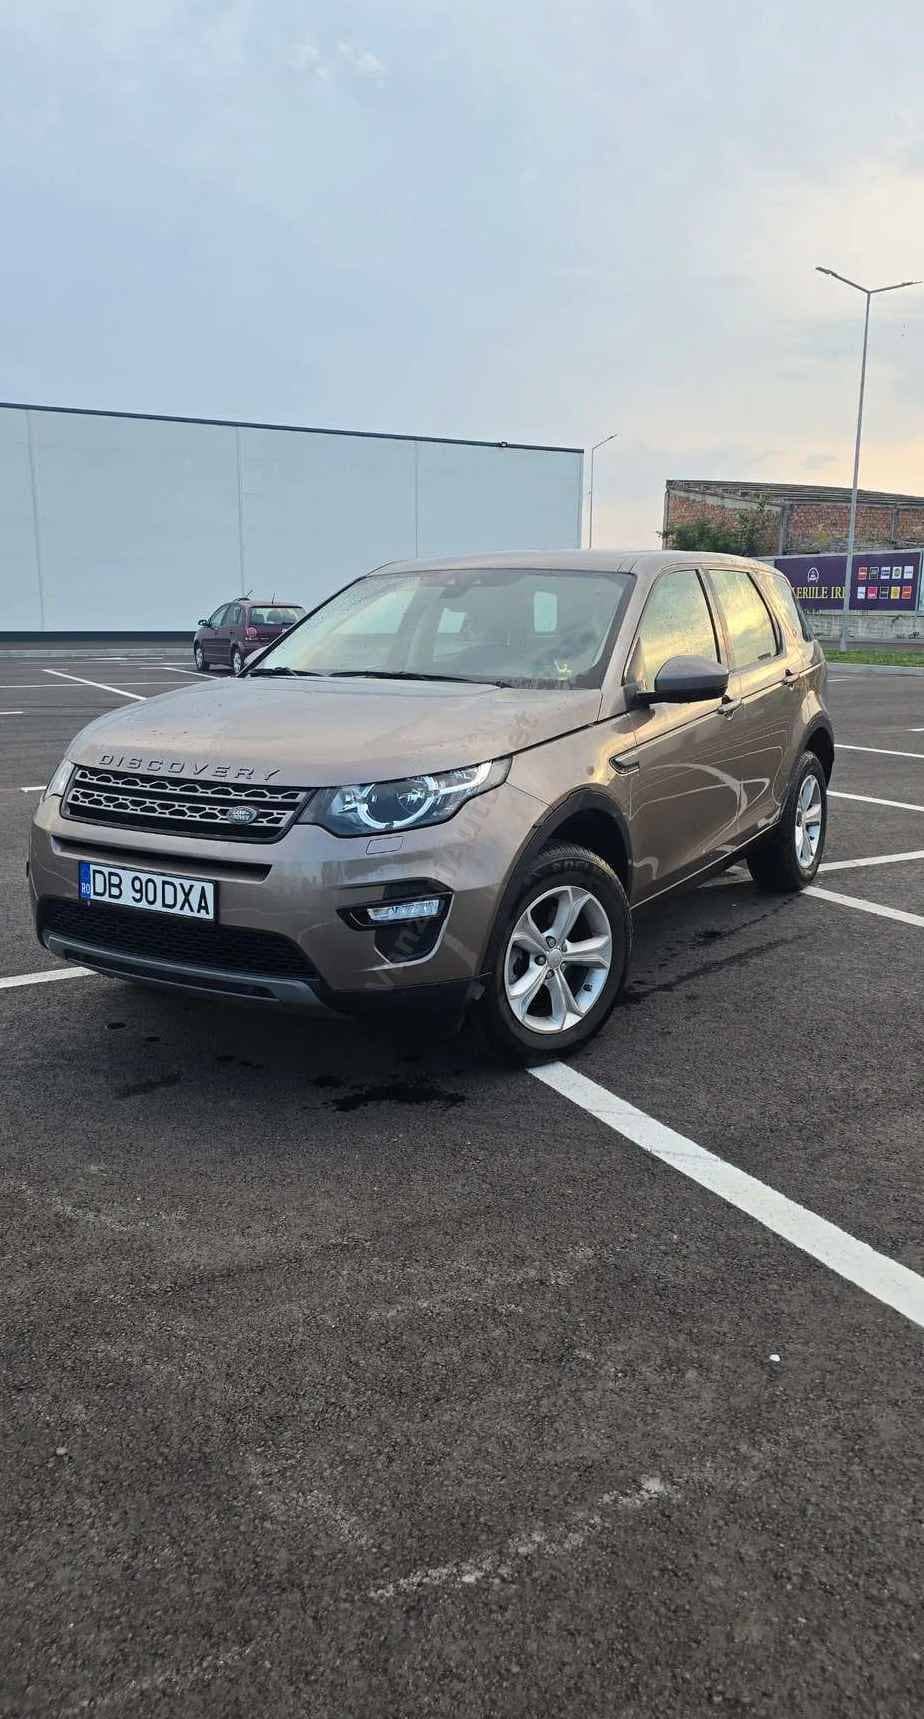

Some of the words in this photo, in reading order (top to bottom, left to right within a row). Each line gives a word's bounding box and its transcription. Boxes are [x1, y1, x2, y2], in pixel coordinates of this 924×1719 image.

[98, 754, 281, 782] DISCOVERY
[81, 882, 91, 894] RO
[93, 869, 122, 899] DB
[131, 876, 157, 905] 90
[162, 880, 210, 915] DXA
